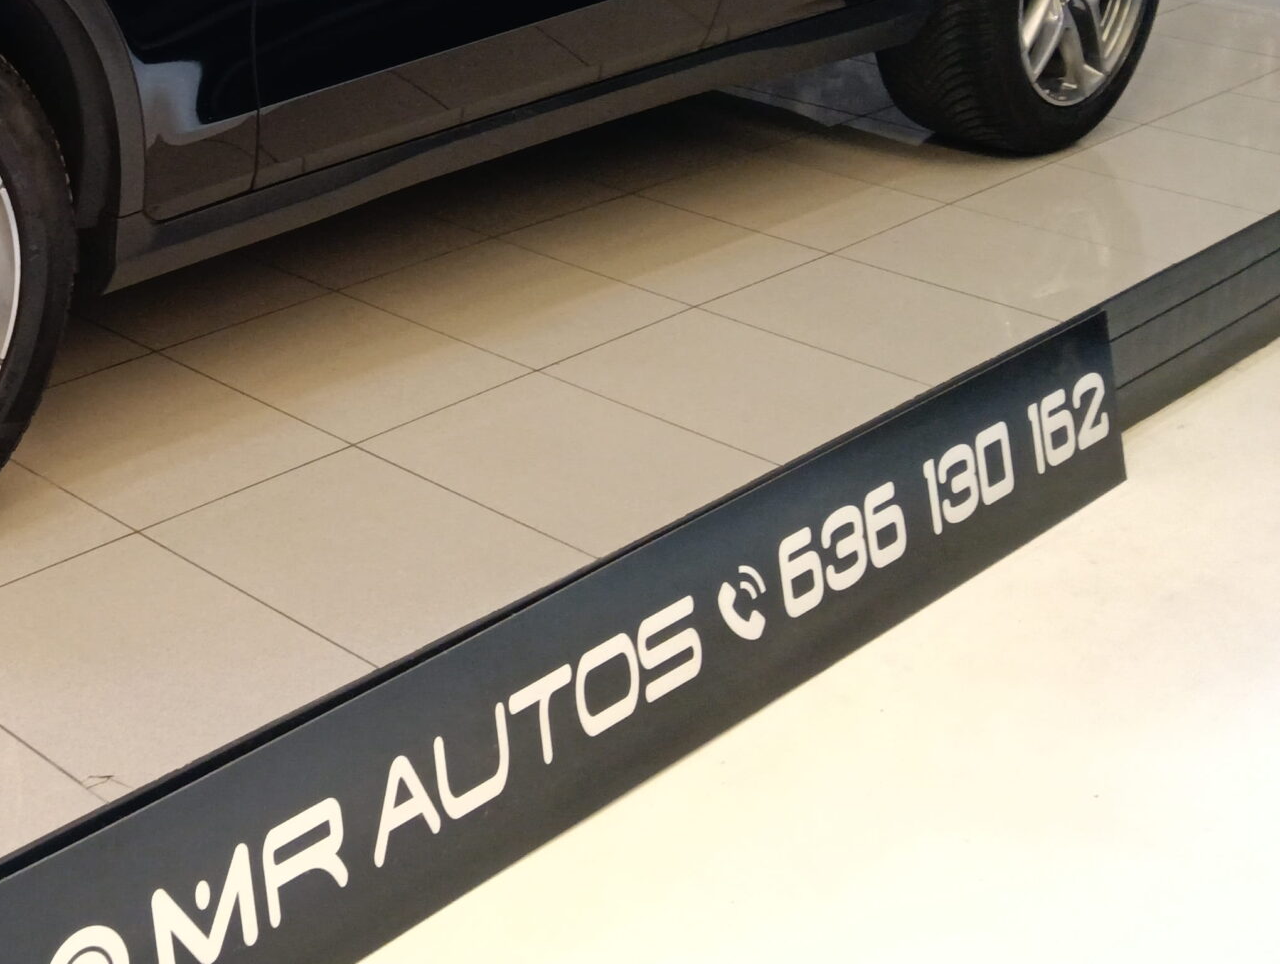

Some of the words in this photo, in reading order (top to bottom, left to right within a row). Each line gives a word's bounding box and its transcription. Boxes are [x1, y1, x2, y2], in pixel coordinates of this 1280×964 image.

[151, 798, 348, 964] MR
[374, 595, 702, 867] AUTOS
[778, 481, 907, 618] 636
[923, 420, 1015, 535] 130
[1027, 371, 1110, 475] 162
